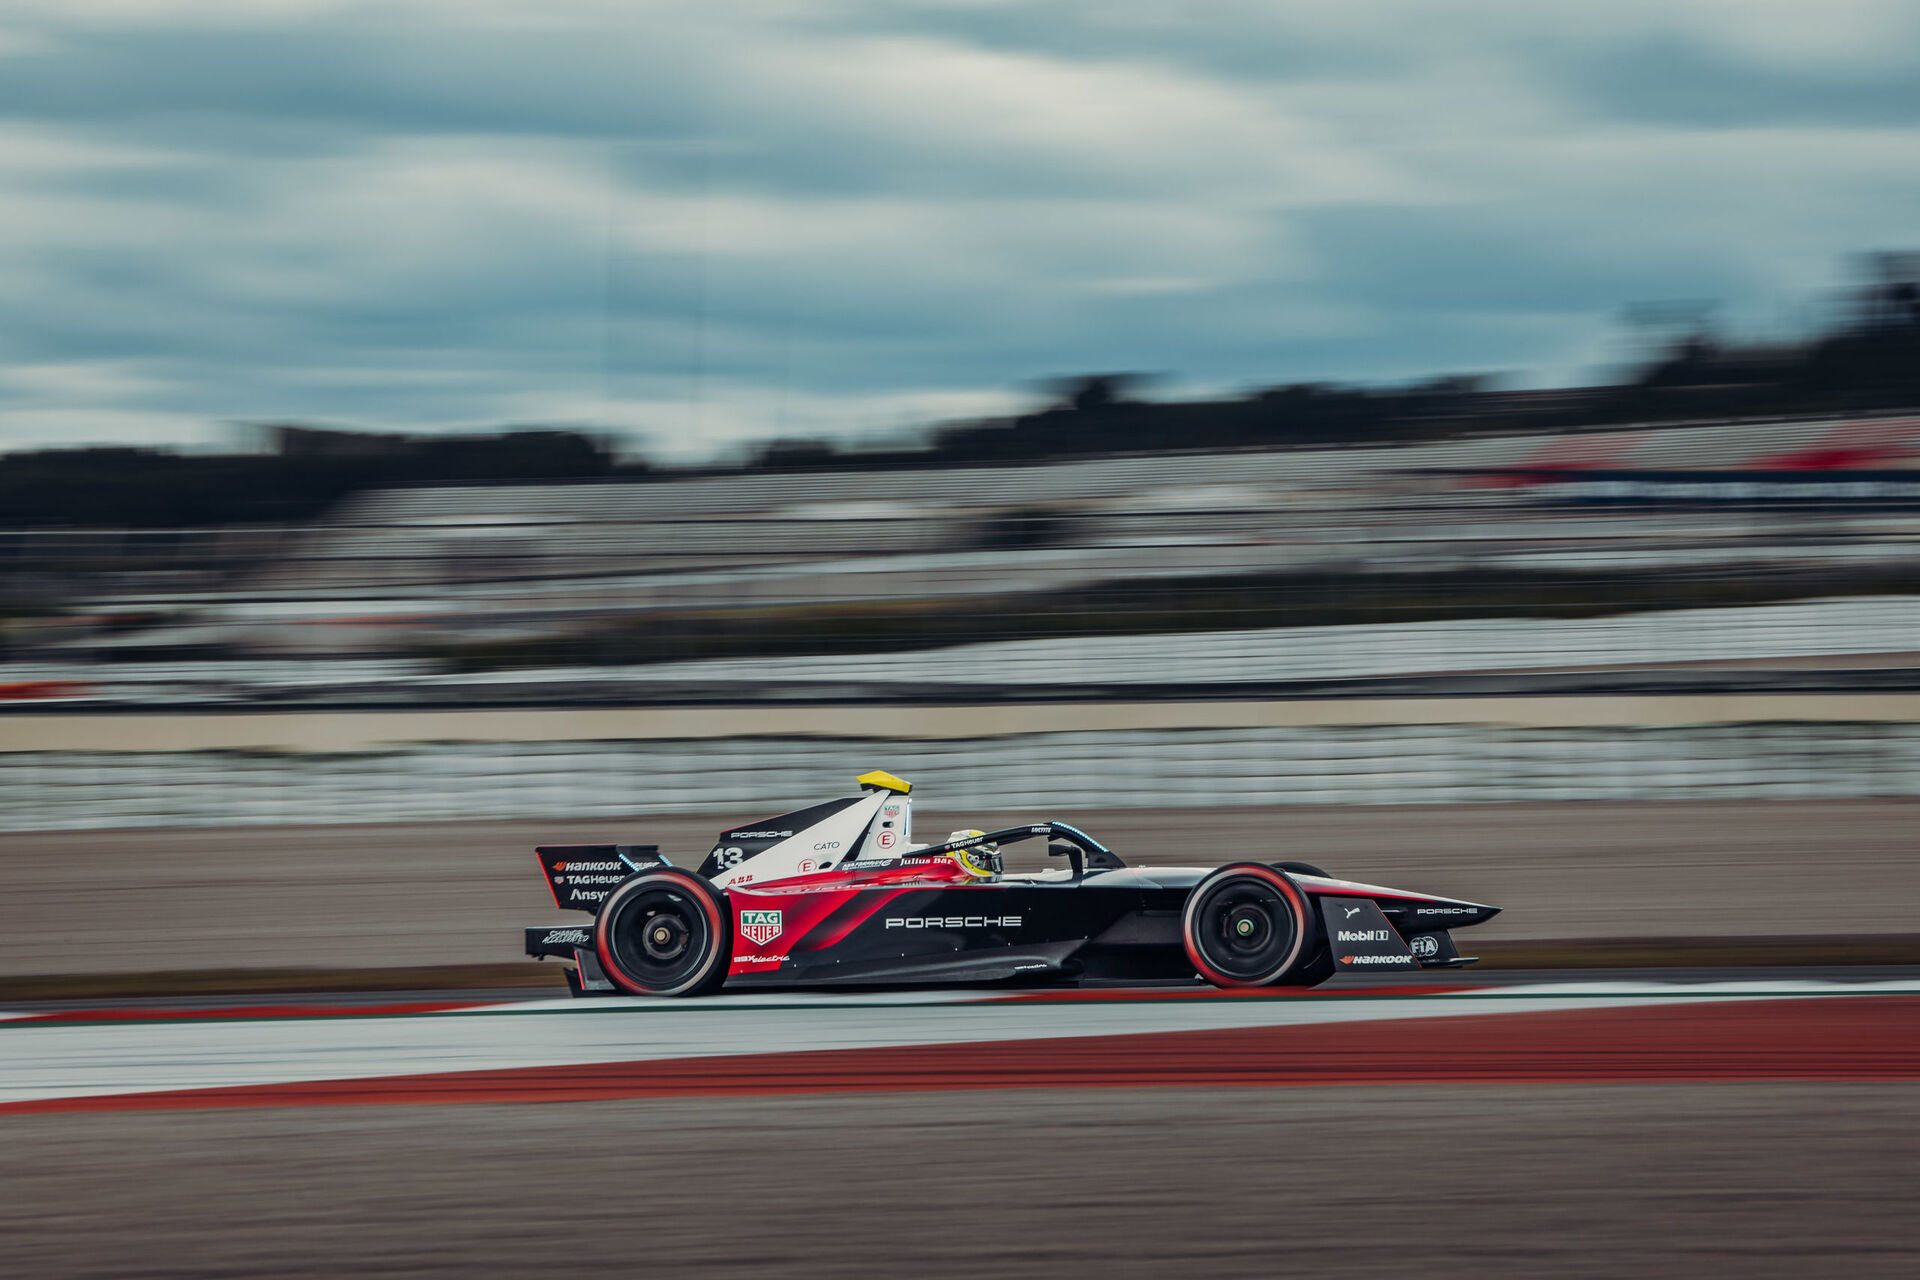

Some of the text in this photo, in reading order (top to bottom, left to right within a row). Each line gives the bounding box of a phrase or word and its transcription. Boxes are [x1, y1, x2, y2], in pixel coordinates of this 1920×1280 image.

[731, 831, 793, 839] PORSCHE
[814, 842, 840, 850] CATO
[713, 847, 744, 869] 13
[900, 858, 931, 866] Julius
[728, 875, 753, 885] ABB
[744, 913, 778, 923] TAG
[886, 916, 1022, 929] PORSCHE
[743, 925, 780, 942] HEUER
[1338, 931, 1374, 941] Mobil
